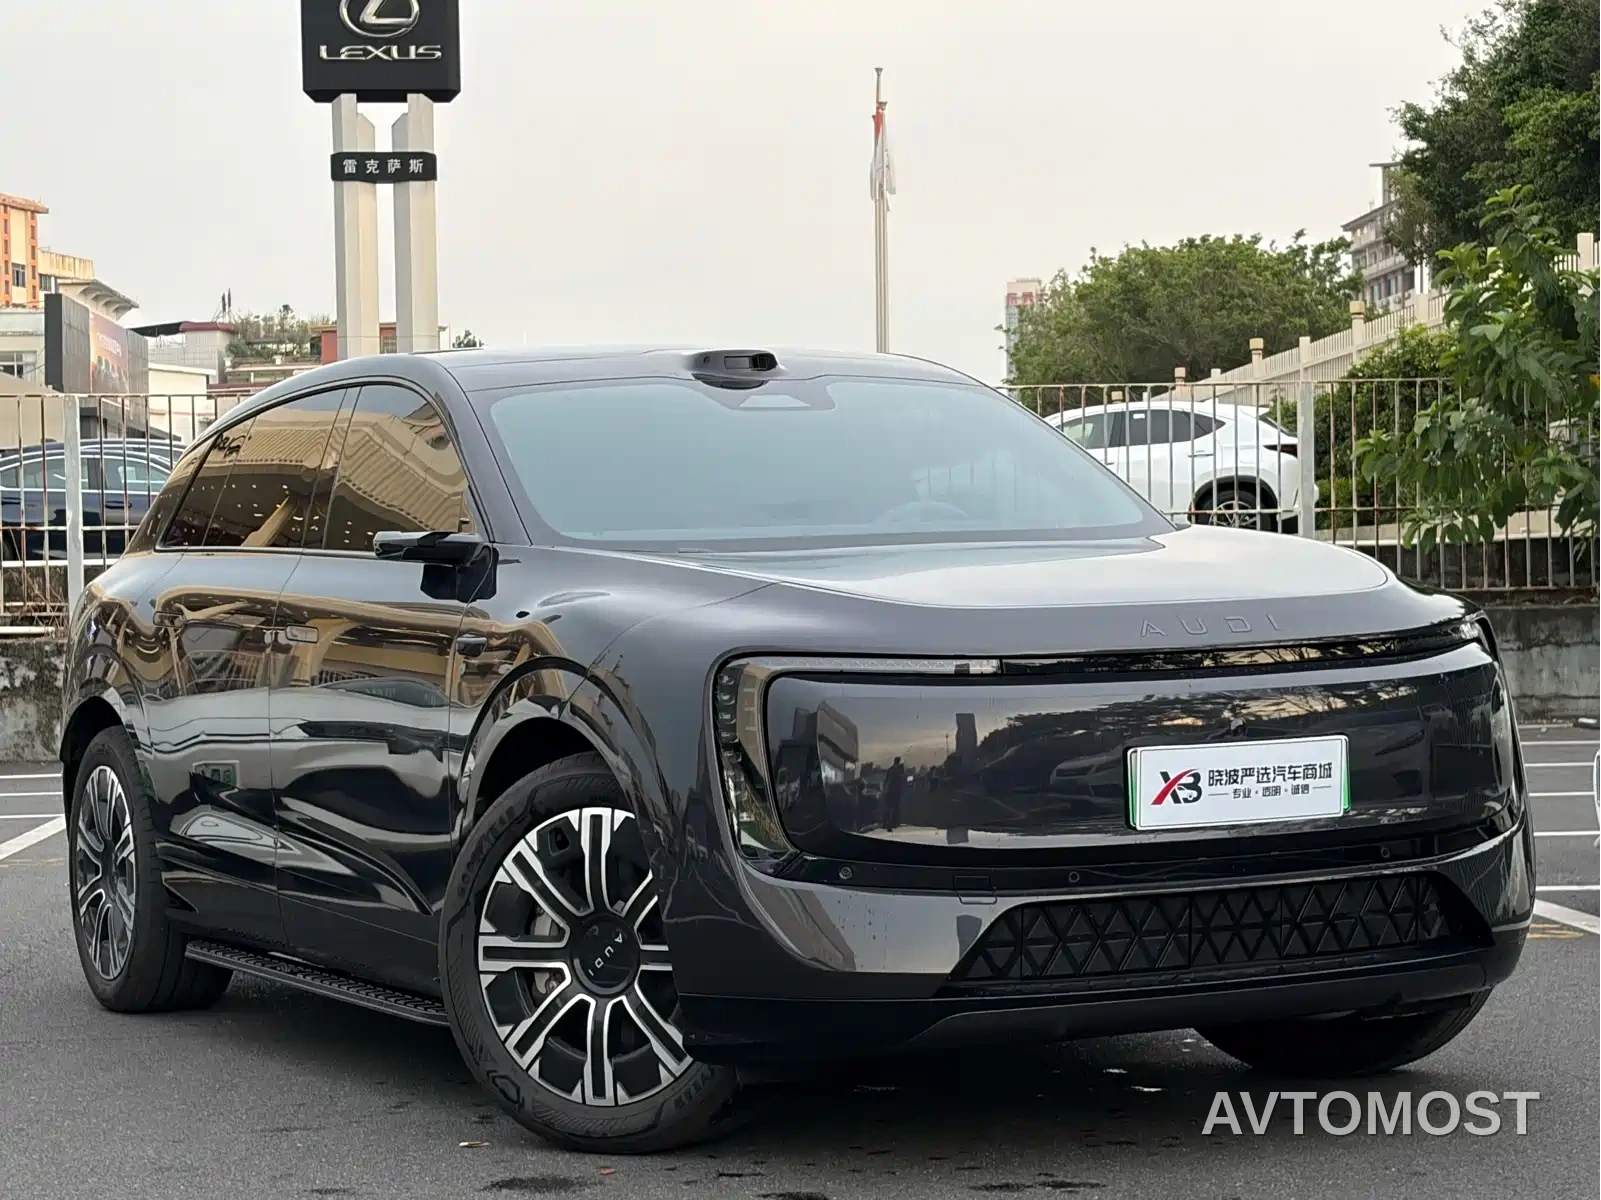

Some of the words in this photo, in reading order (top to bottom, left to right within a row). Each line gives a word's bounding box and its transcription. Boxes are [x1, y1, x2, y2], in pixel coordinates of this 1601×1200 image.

[319, 45, 442, 60] LEXUS
[342, 158, 424, 174] 雷克萨斯
[1139, 612, 1282, 638] AUDI
[1208, 762, 1333, 787] 晓波严选汽车商城
[588, 932, 623, 976] AUDI
